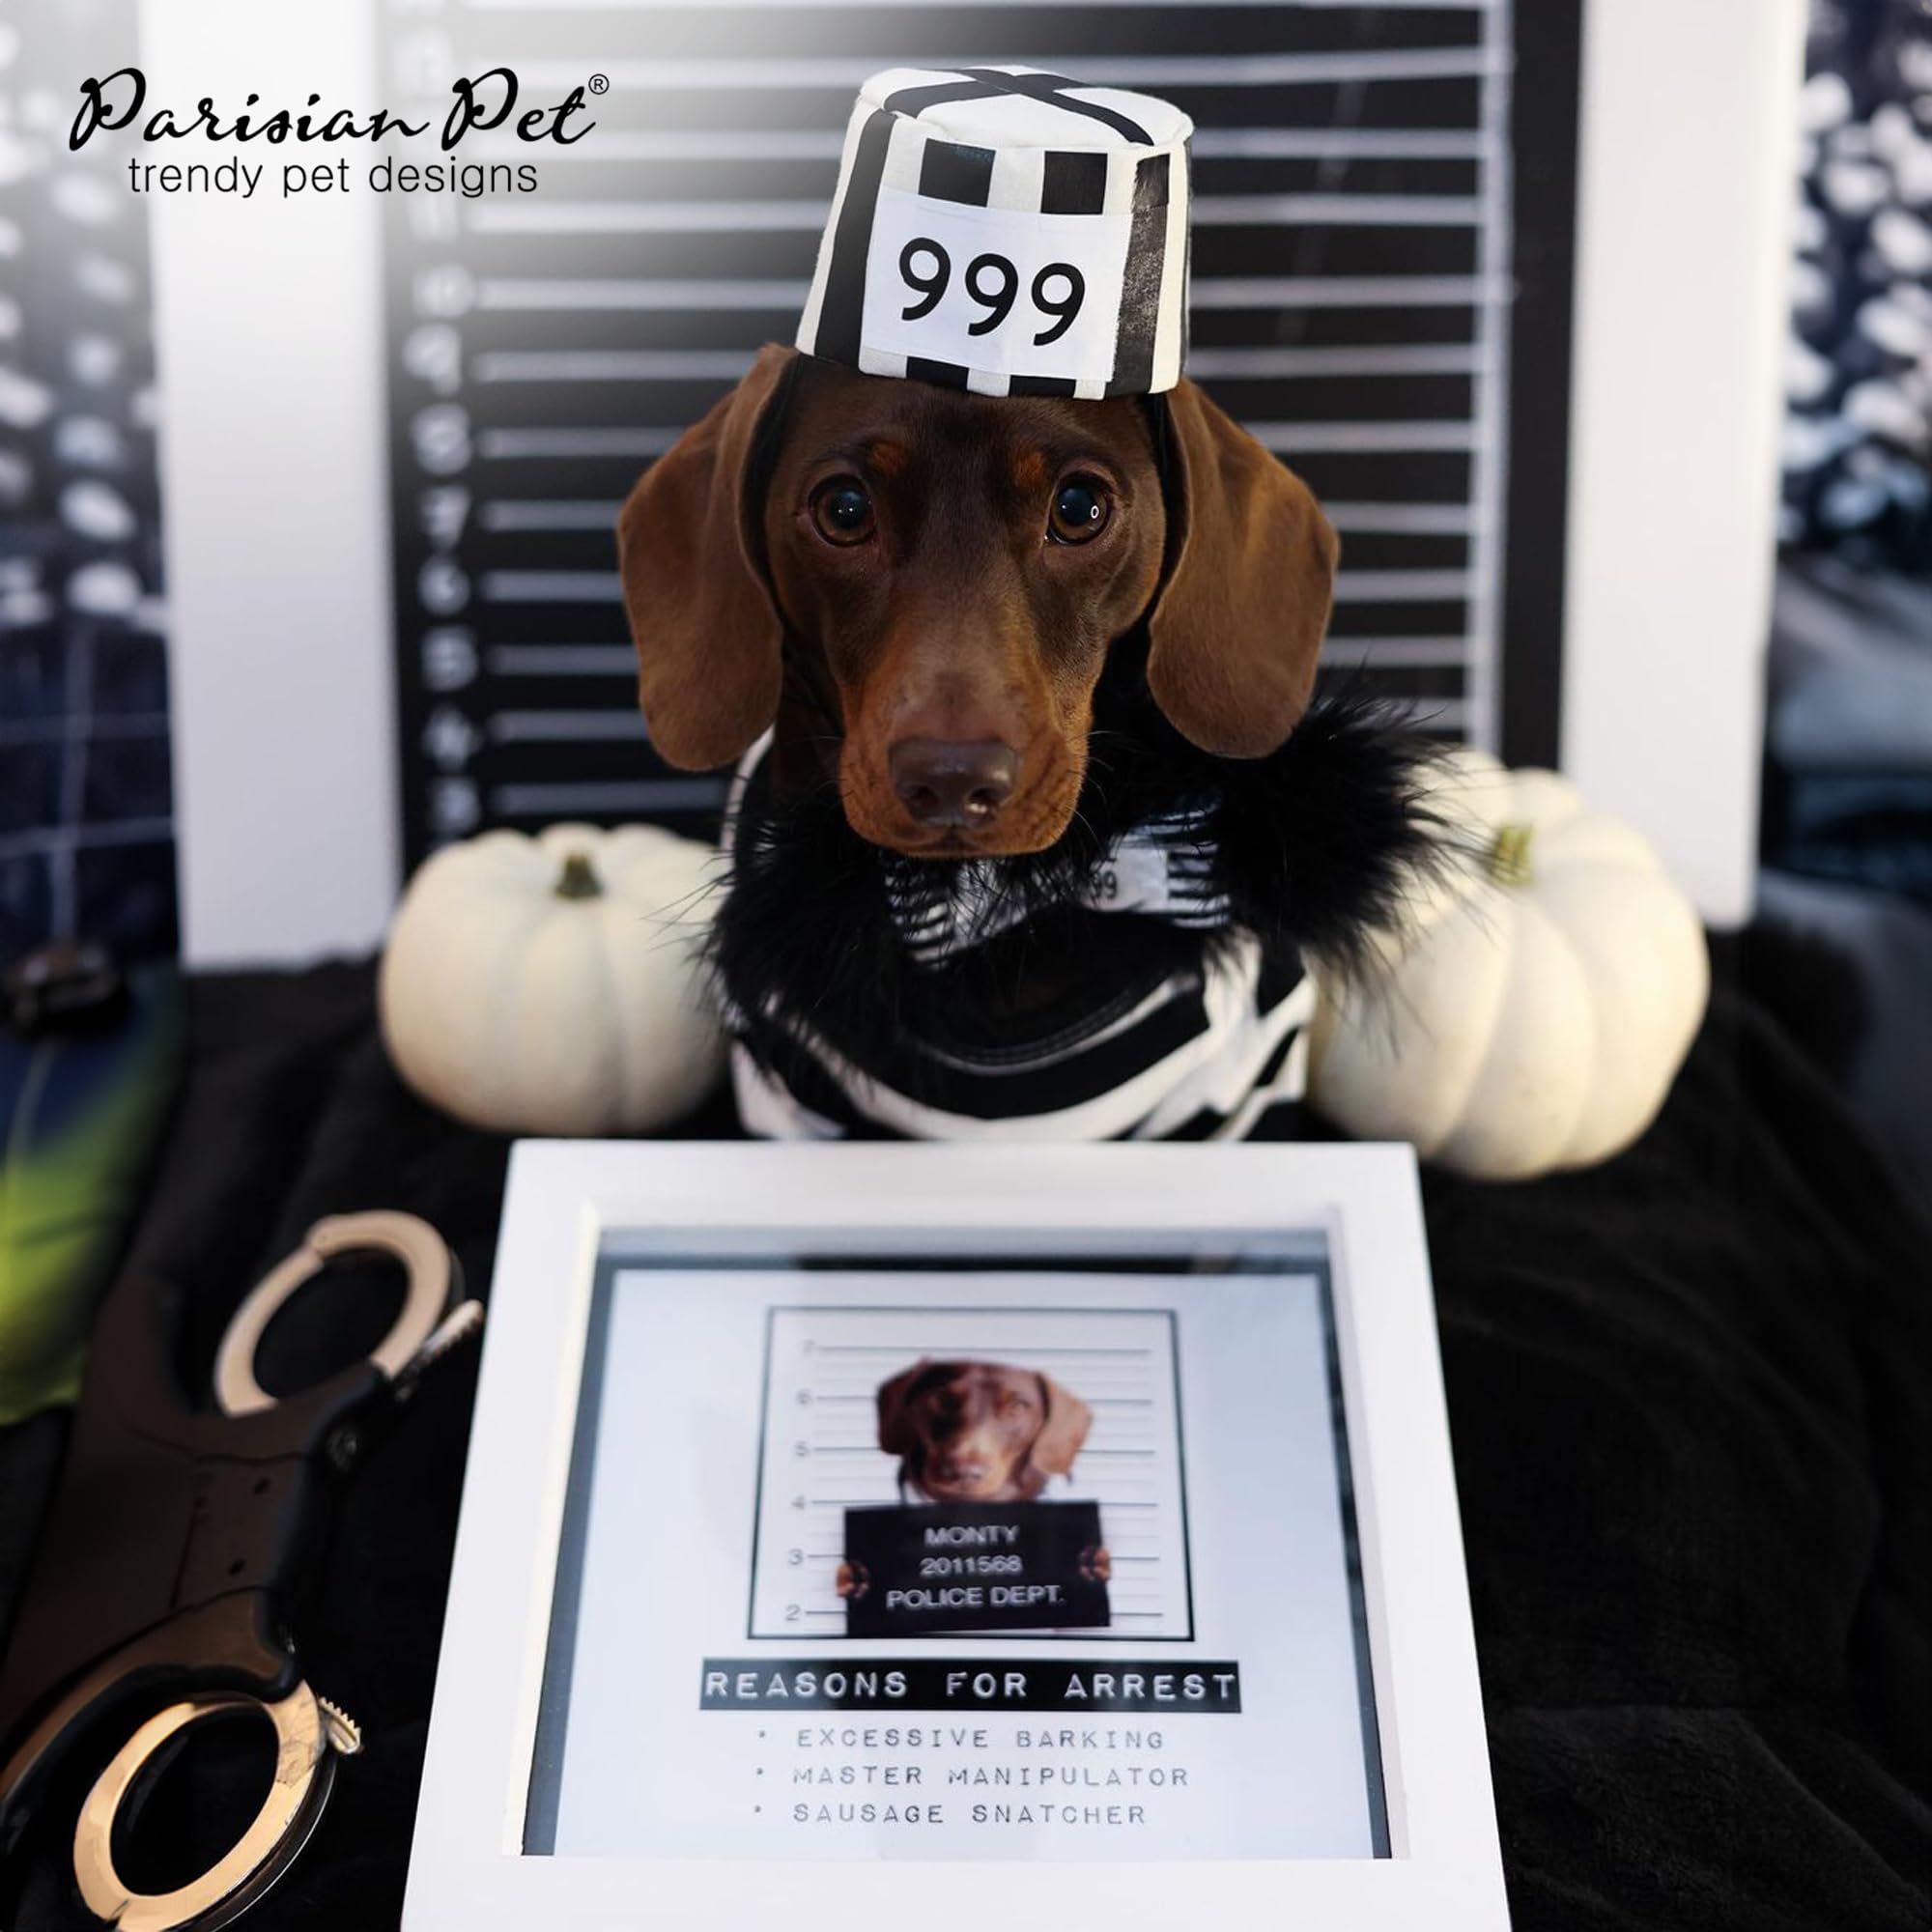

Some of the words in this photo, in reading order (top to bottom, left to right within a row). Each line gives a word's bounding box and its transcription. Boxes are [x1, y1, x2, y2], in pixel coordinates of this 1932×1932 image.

[898, 237, 1086, 346] 999
[923, 1525, 1019, 1547] MONTY
[788, 1548, 804, 1566] 3
[920, 1554, 1023, 1577] 2011568
[886, 1586, 983, 1608] POLICE
[785, 1604, 802, 1622] 2
[705, 1671, 909, 1699] REASONS
[946, 1671, 1028, 1698] FOR
[1064, 1673, 1236, 1701] ARREST
[797, 1728, 989, 1749] EXCESSIVE
[1016, 1729, 1164, 1750] BARKING
[792, 1765, 923, 1785] MASTER
[948, 1766, 1189, 1787] MANIPULATOR
[792, 1803, 945, 1824] SAUSAGE
[971, 1804, 1146, 1825] SNATCHER
